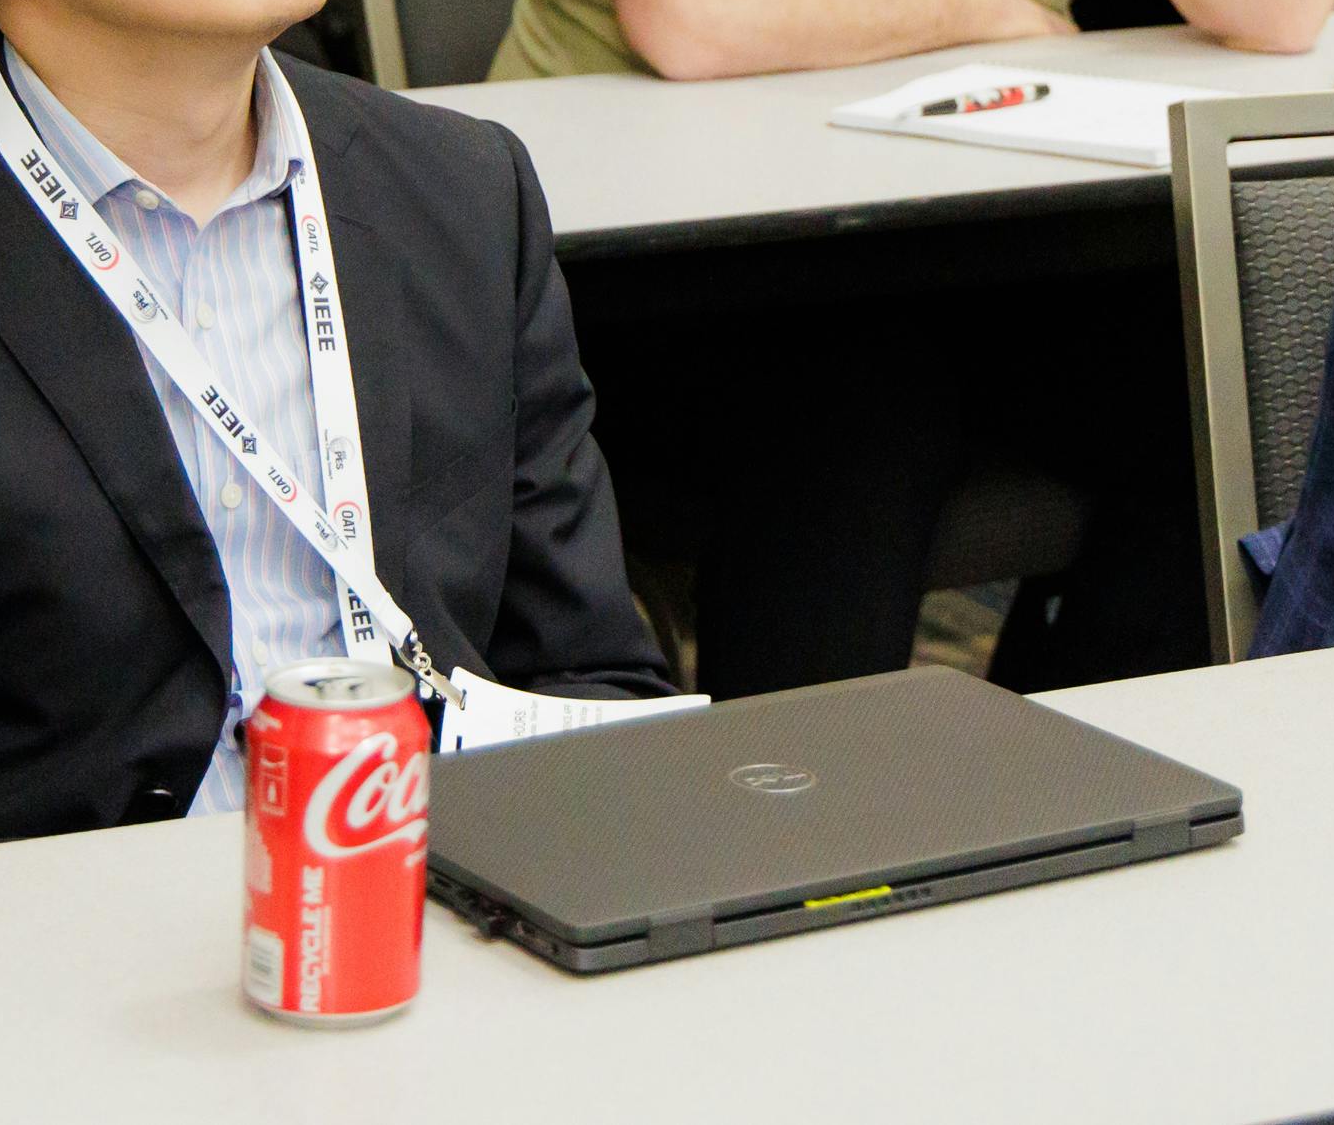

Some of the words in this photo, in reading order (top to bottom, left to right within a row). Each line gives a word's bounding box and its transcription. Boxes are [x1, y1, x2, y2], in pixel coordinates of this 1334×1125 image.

[20, 148, 67, 204] IEEE
[85, 235, 113, 263] OATI
[313, 297, 336, 352] IEEE
[201, 385, 245, 438] IEEE
[267, 468, 292, 495] OATI
[341, 510, 357, 541] OATI
[303, 865, 324, 904] ME
[300, 906, 323, 1013] RECYCLE
